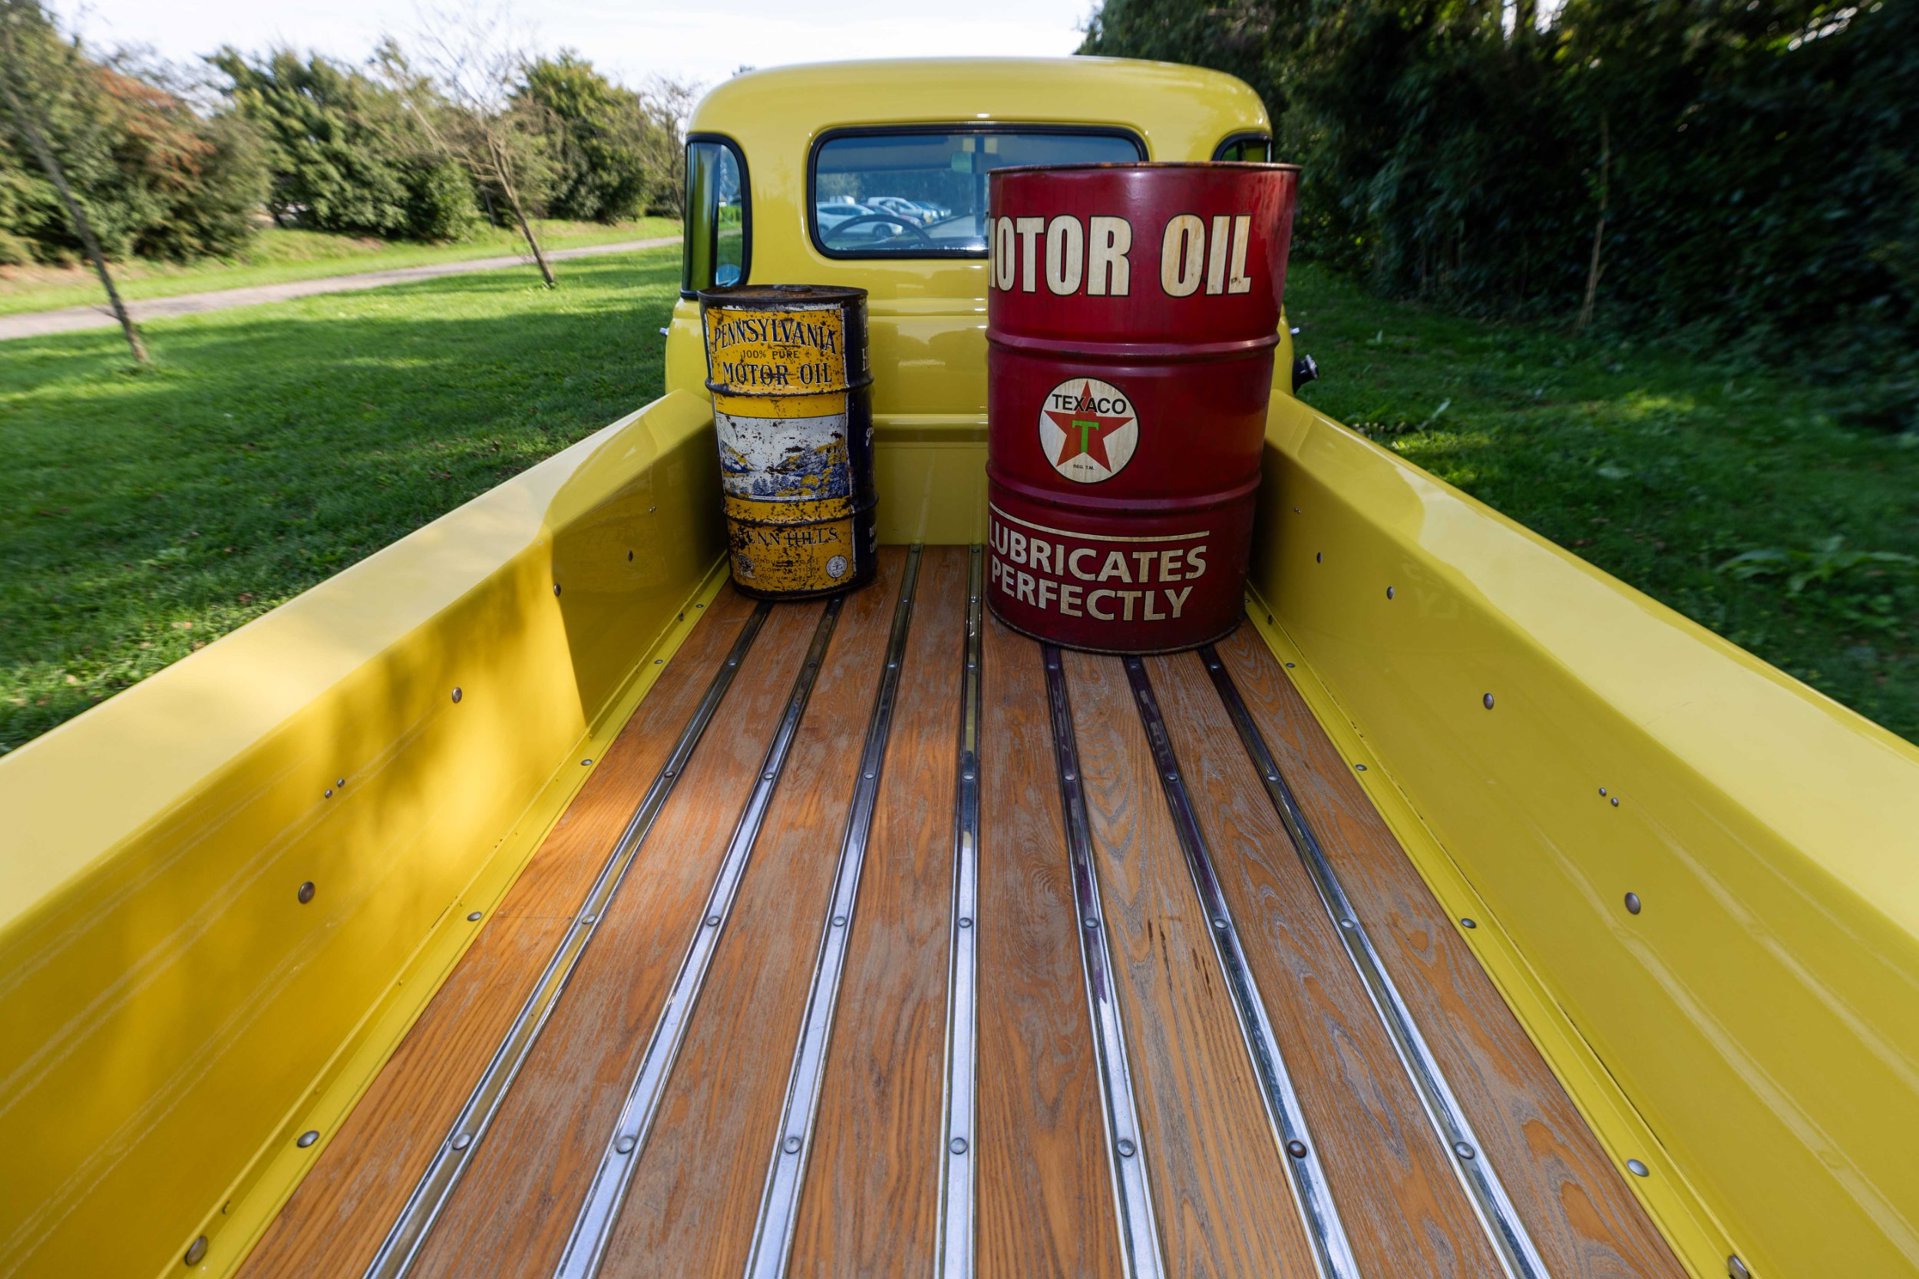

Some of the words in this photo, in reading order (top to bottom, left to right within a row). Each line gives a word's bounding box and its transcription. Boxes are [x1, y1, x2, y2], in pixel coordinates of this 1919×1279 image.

[1161, 214, 1251, 297] OIL
[714, 318, 837, 354] PENNSYLVANIA
[743, 349, 767, 359] 100%
[772, 350, 800, 359] PURE
[723, 362, 789, 385] MOTOR
[800, 362, 832, 385] OIL
[1052, 394, 1127, 415] TEXACO
[1072, 420, 1099, 454] T
[989, 514, 1207, 583] LUBRICATES
[991, 555, 1193, 621] PERFECTLY
